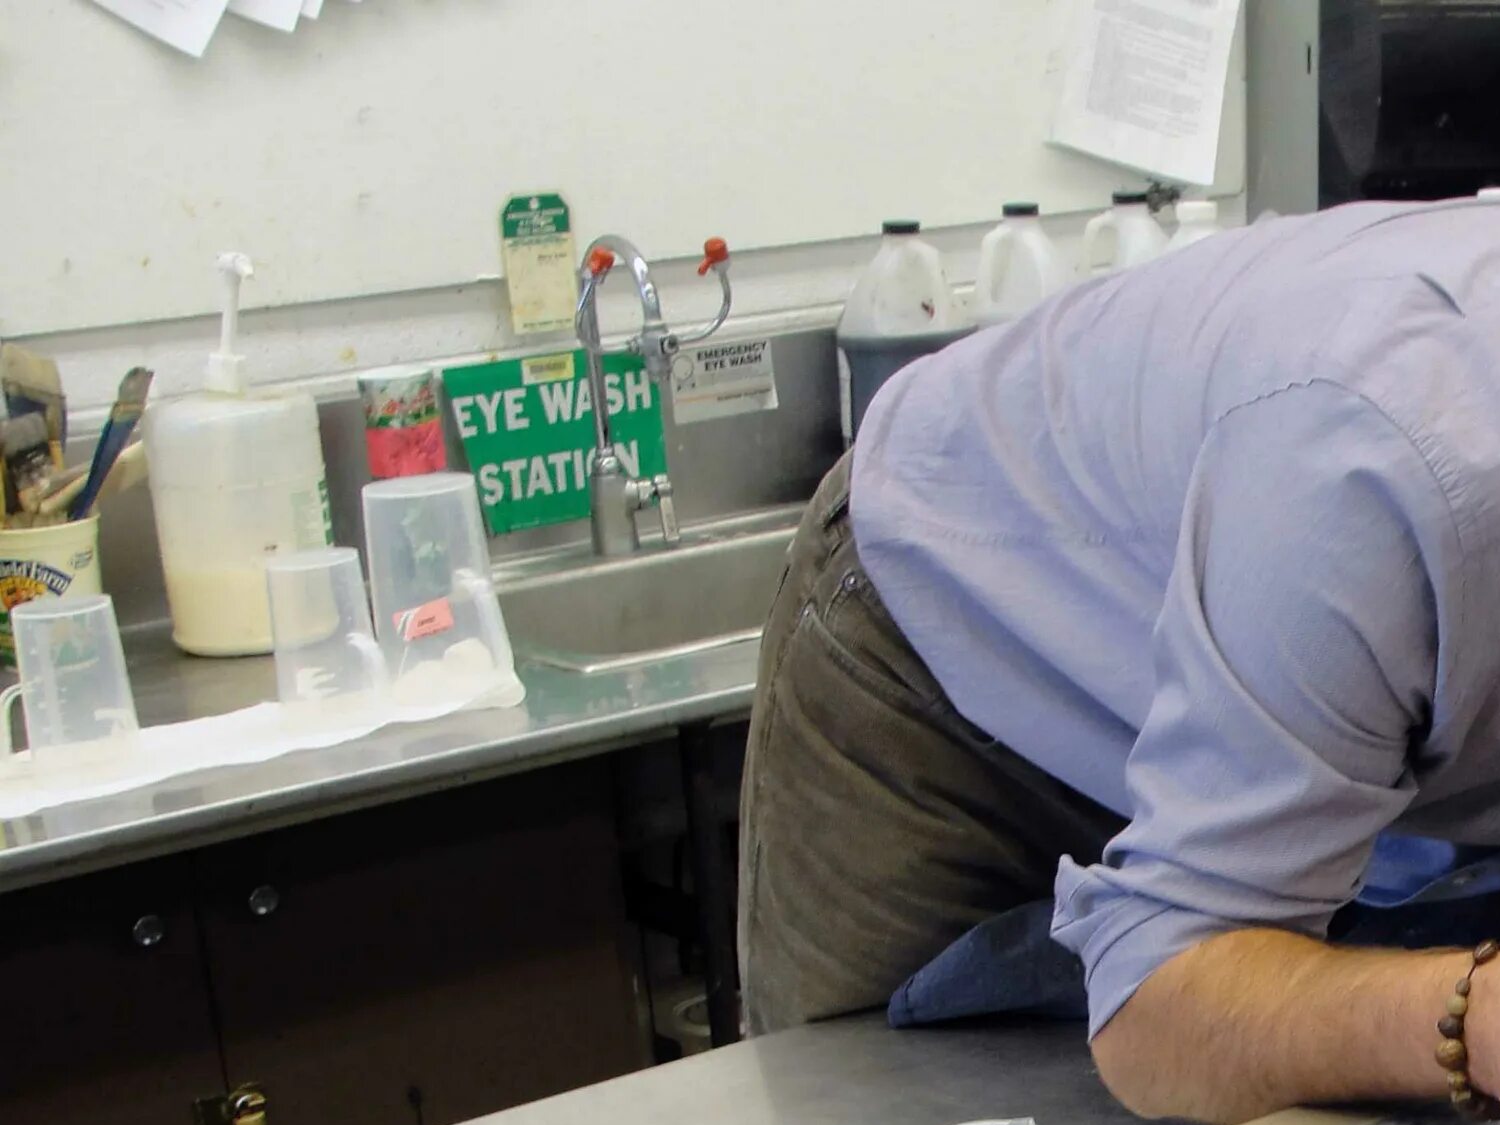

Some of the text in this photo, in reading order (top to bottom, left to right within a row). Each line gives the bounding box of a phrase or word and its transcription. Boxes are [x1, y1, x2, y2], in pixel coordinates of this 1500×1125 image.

[696, 340, 767, 362] EMERGENCY
[704, 353, 762, 372] EYE WASH
[451, 386, 531, 439] EYE
